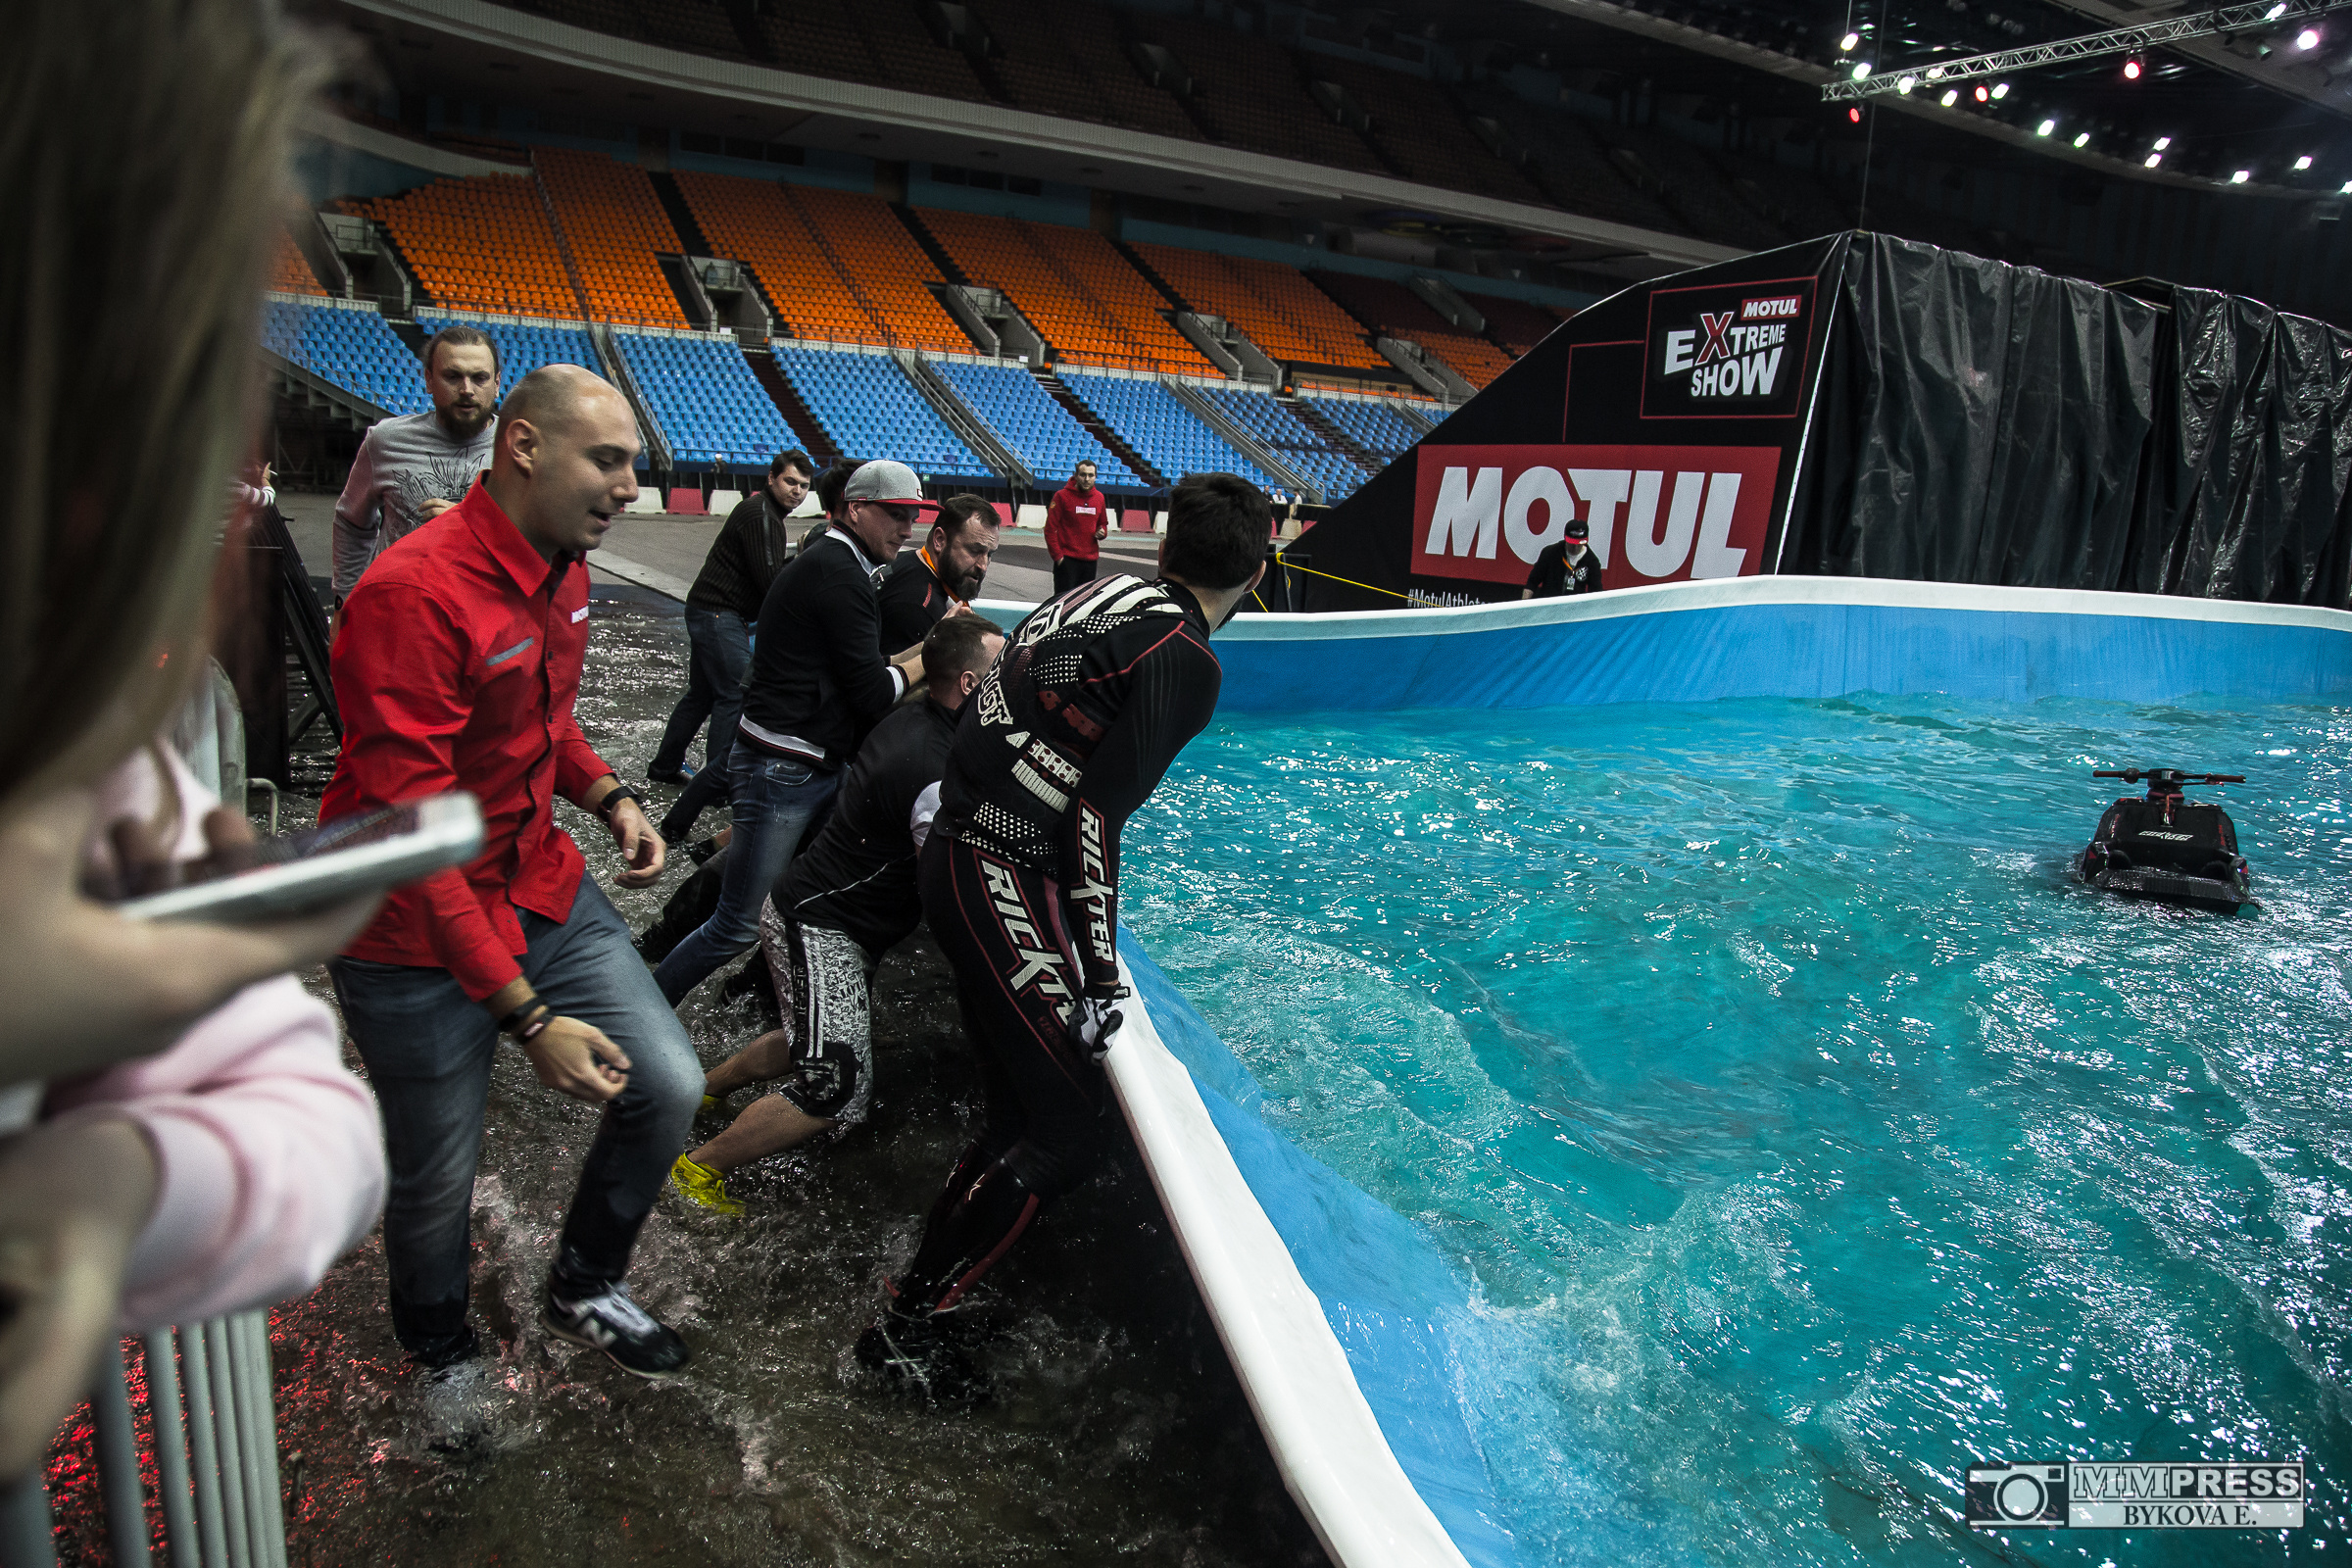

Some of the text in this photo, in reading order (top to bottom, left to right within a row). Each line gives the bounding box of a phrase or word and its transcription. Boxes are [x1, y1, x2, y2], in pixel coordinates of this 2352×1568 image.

[1664, 311, 1787, 375] EXTREME
[1742, 299, 1797, 318] MOTUL
[1690, 346, 1784, 397] SHOW
[1424, 466, 1747, 579] MOTUL
[1070, 807, 1114, 962] RICKTER
[981, 859, 1076, 1027] RICKT
